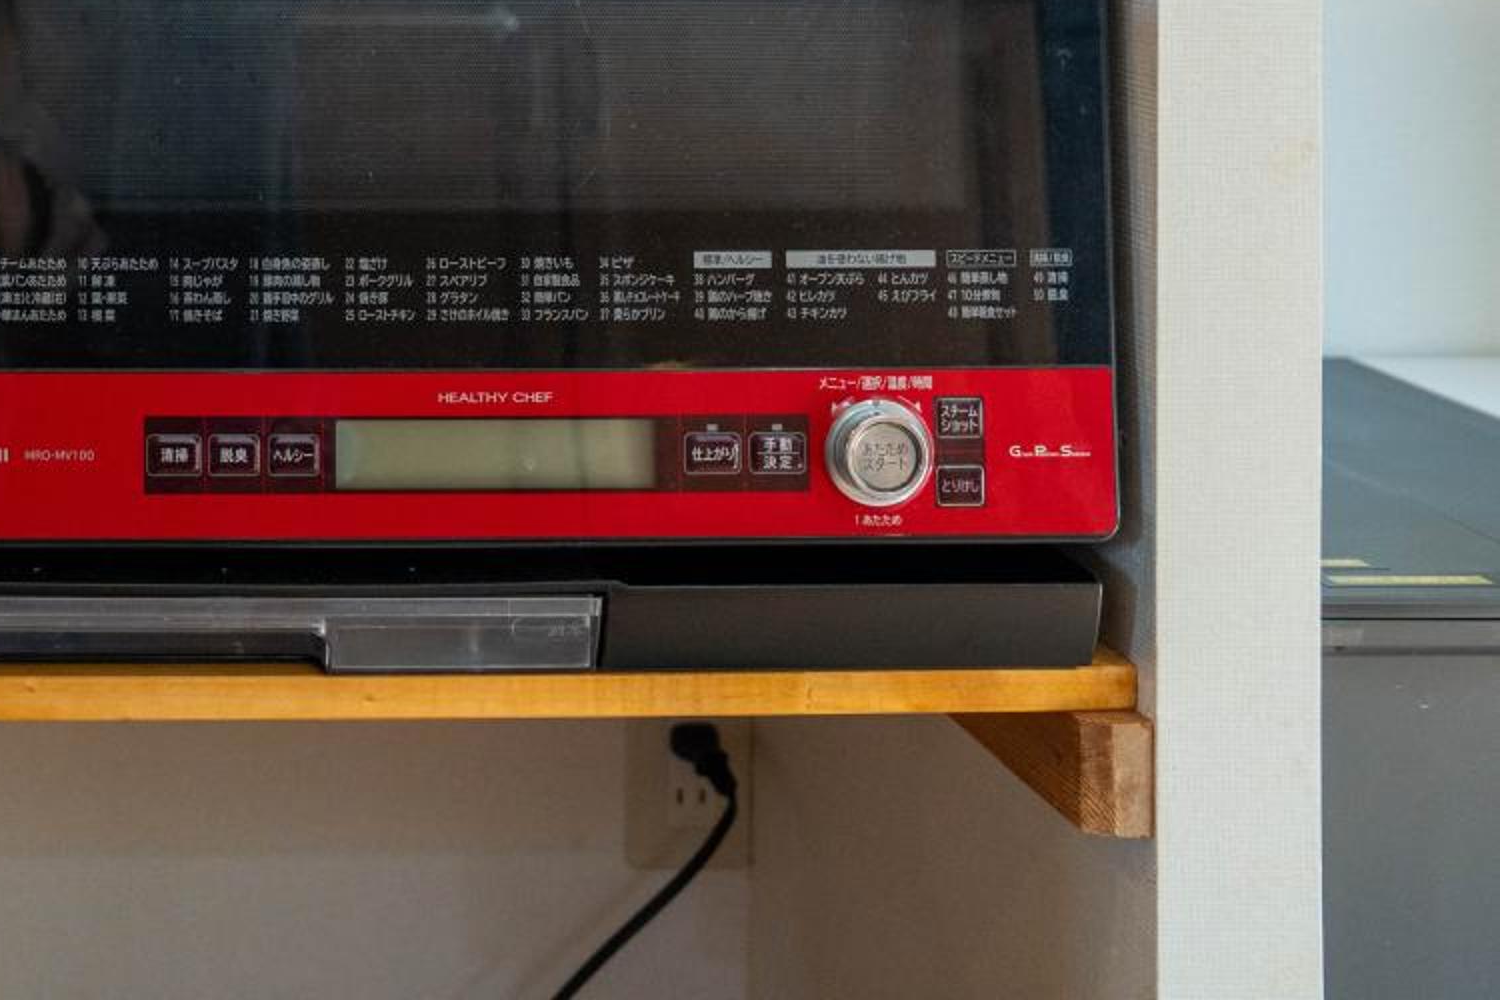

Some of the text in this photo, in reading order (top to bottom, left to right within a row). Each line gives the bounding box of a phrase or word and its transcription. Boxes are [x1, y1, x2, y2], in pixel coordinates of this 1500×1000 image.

[183, 257, 238, 270] スープパスタ
[439, 257, 506, 270] ローストビーフ
[613, 256, 635, 269] ピザ
[358, 274, 413, 287] ポークグリル
[439, 274, 488, 287] スペアリブ
[613, 274, 676, 286] スポンジケーキ
[708, 274, 755, 286] ハンバーグ
[891, 273, 928, 285] とんカツ
[439, 292, 478, 304] グラタン
[800, 290, 836, 302] ヒレカツ
[891, 290, 936, 302] えびフライ
[358, 310, 416, 321] ローストチキン
[534, 310, 589, 321] フランスパン
[800, 308, 847, 319] チキンカツ
[437, 391, 555, 403] HEALTHY CHEF
[941, 406, 978, 419] スチーム
[762, 437, 793, 452] 手動
[863, 440, 907, 456] あたため
[273, 448, 314, 463] ヘルシー
[762, 454, 793, 470] 決定
[863, 456, 908, 473] スタート
[941, 478, 979, 493] とりけし
[862, 514, 902, 527] あたため
